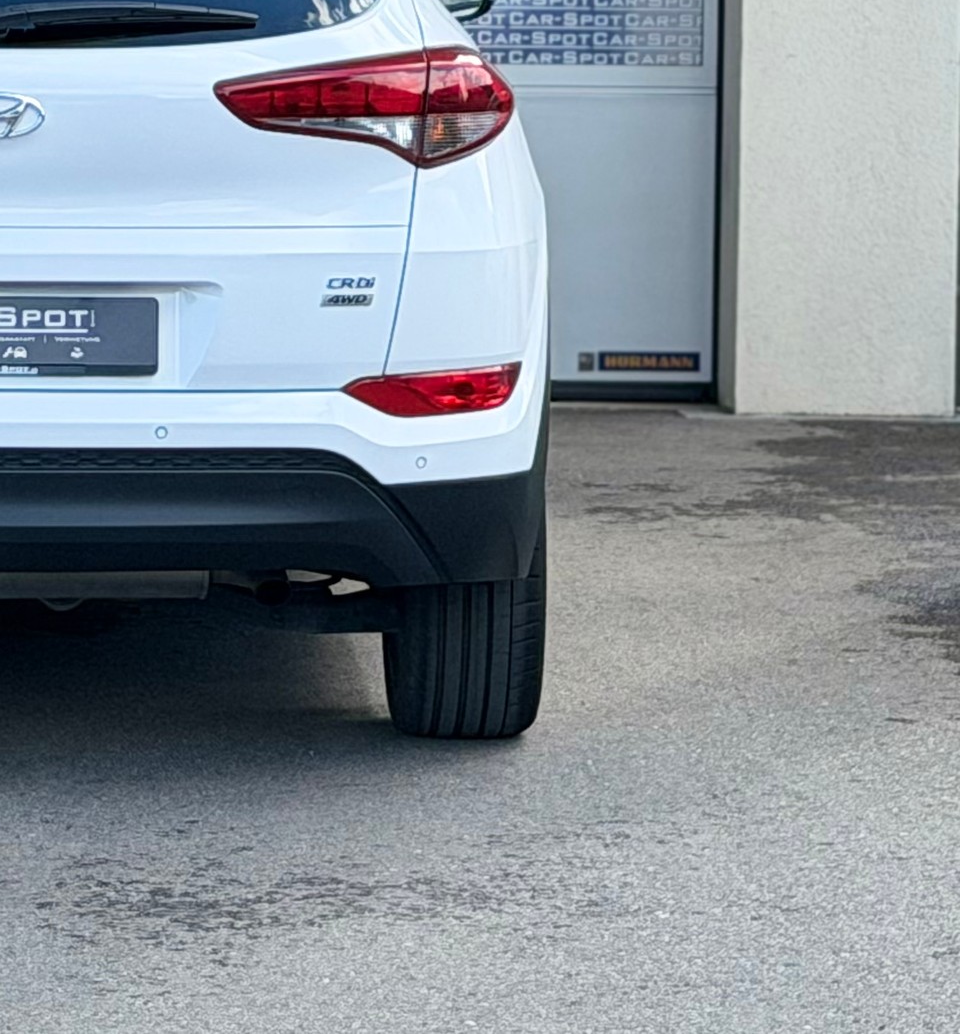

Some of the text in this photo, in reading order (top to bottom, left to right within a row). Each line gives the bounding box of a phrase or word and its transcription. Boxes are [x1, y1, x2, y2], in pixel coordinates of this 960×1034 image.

[509, 11, 623, 26] CAR-SPOT
[508, 50, 622, 64] CAR-SPOT
[327, 294, 368, 304] 4WD
